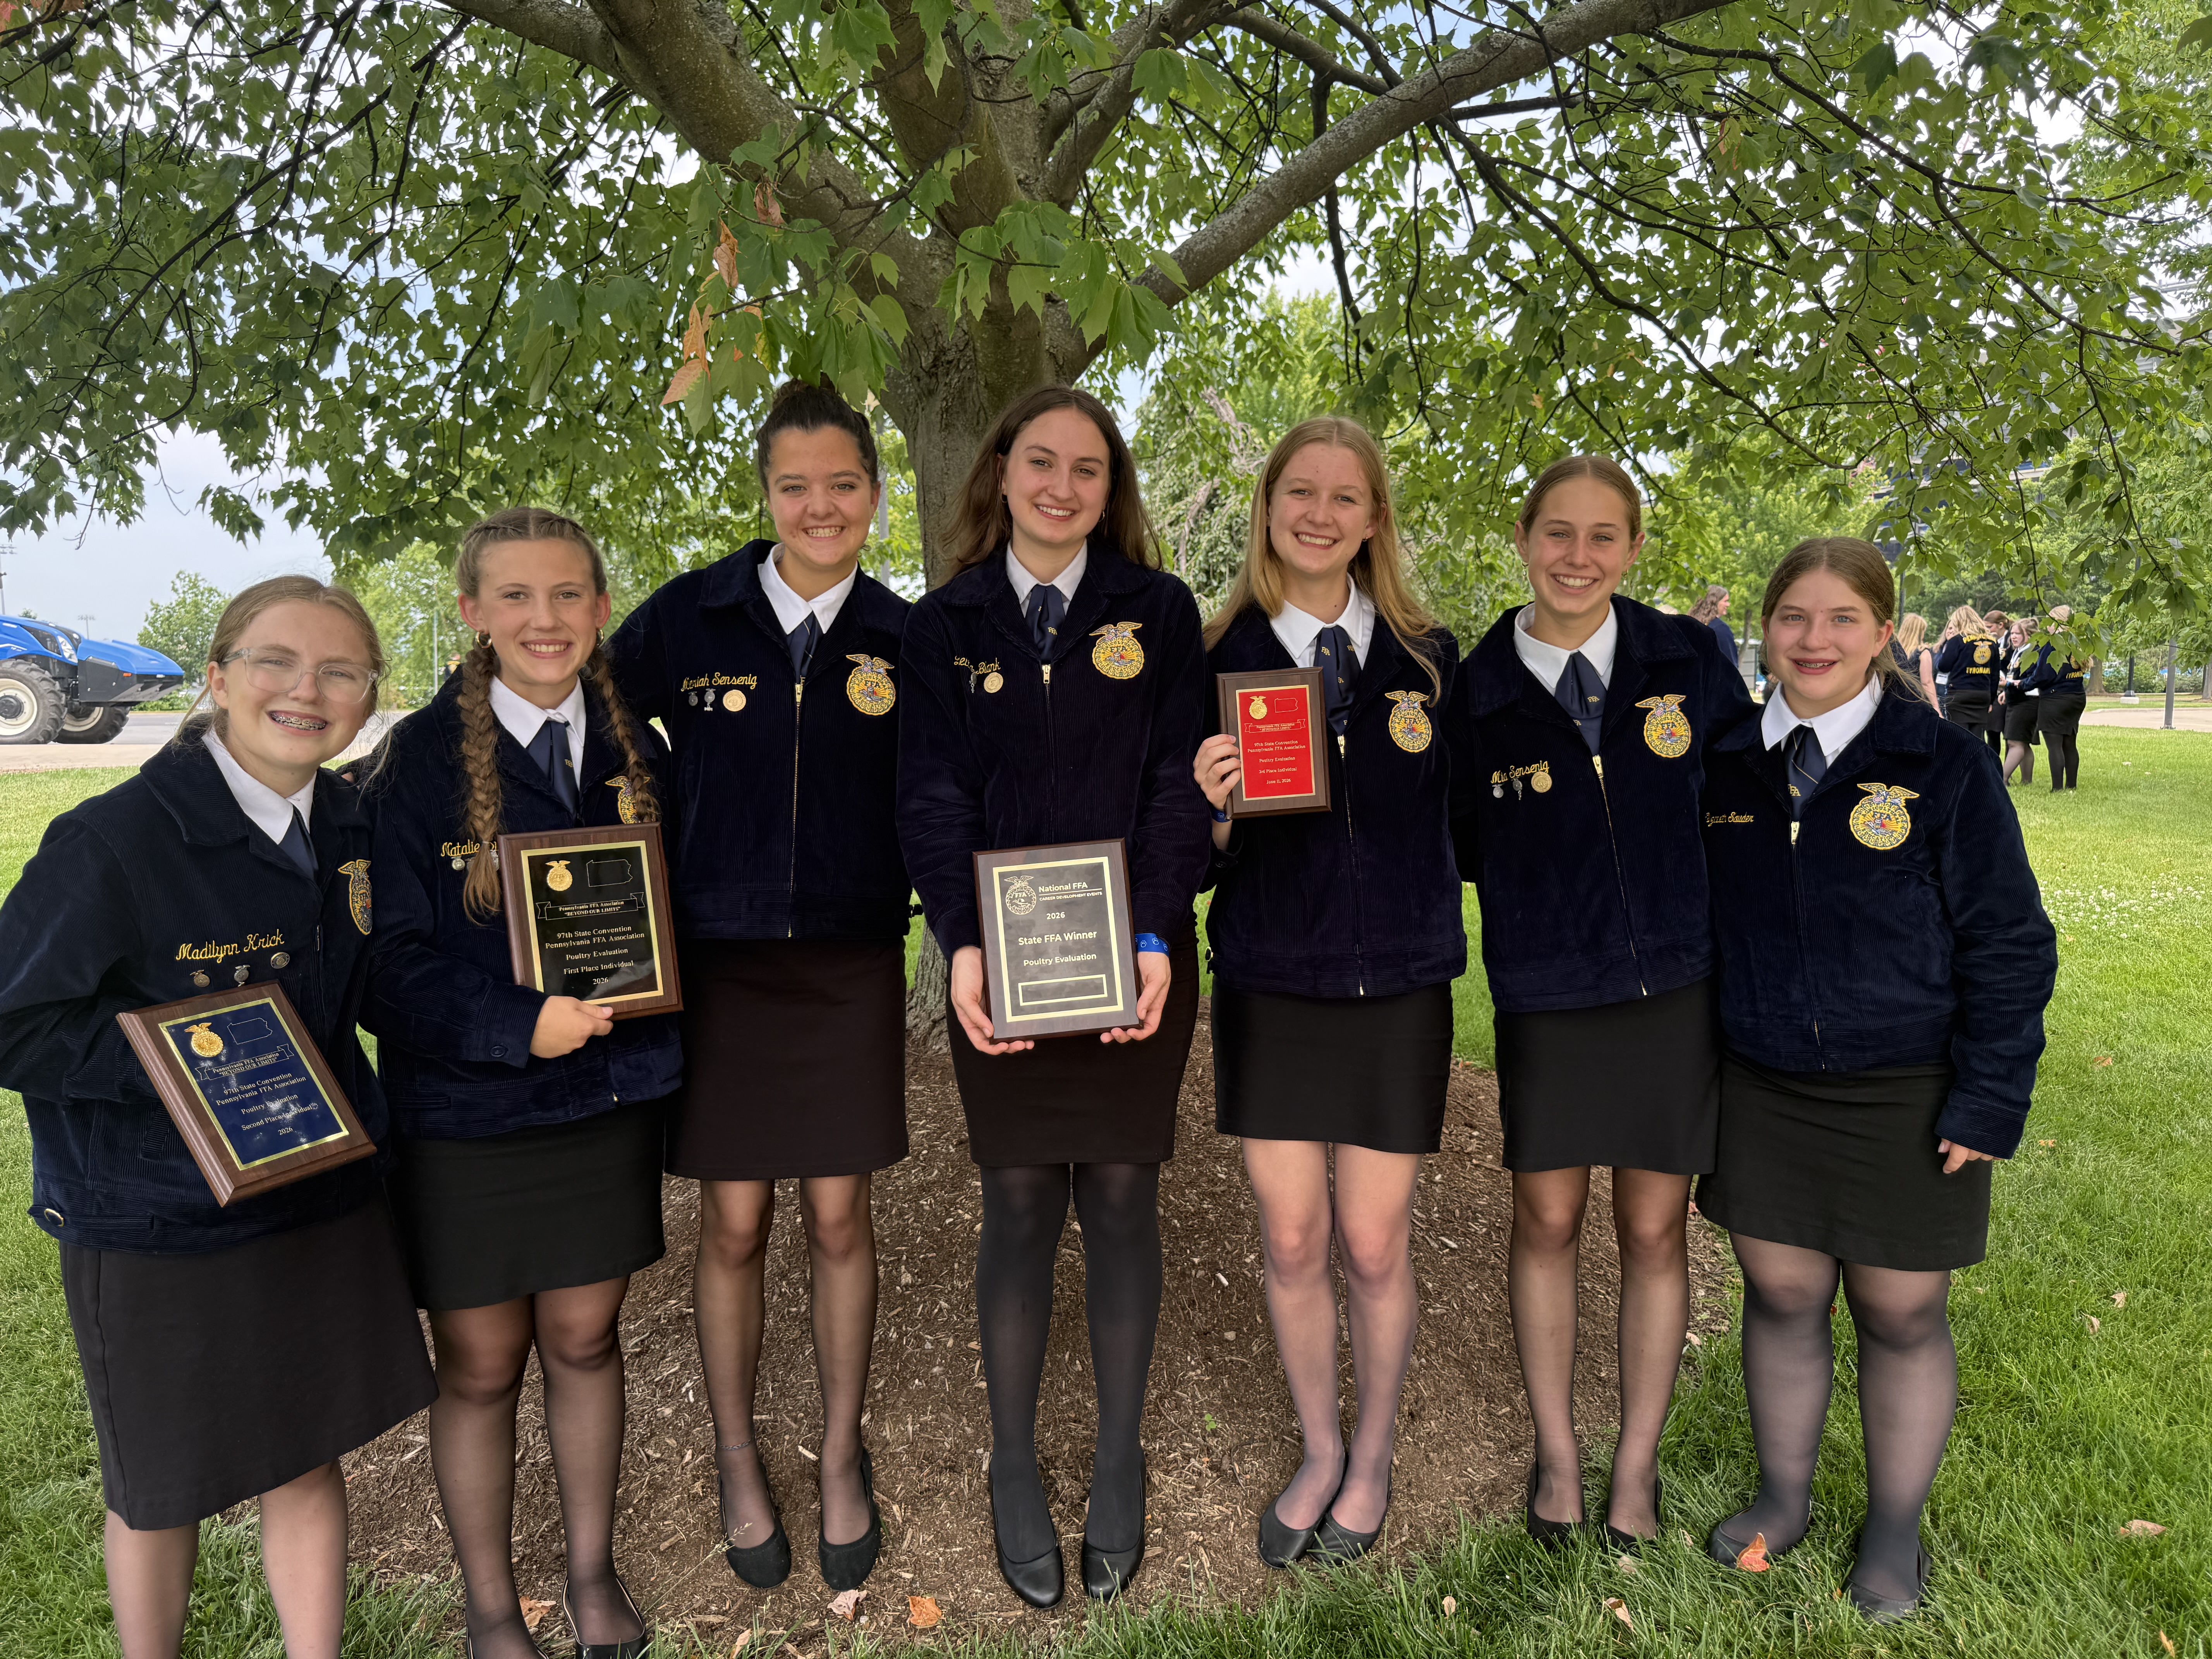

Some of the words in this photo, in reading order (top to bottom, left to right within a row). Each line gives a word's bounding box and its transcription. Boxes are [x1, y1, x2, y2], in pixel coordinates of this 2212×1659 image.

[1048, 627, 1057, 635] FFA
[1321, 646, 1330, 656] FFA
[712, 672, 757, 689] Sensenig
[1491, 770, 1508, 783] Mia
[1509, 760, 1549, 778] Sensenig
[1728, 812, 1754, 823] Sauder
[1872, 811, 1892, 821] FFA
[441, 839, 480, 857] Natalie
[1039, 883, 1071, 893] National
[1046, 912, 1065, 920] 2026
[593, 926, 632, 935] Convention
[176, 940, 240, 963] Madilynn
[244, 929, 285, 952] Krick
[545, 938, 590, 949] Pennsylvania
[609, 932, 645, 942] Association
[1018, 936, 1042, 946] State
[1044, 934, 1062, 943] FFA
[1063, 931, 1097, 941] Winner
[566, 953, 591, 961] Poultry
[594, 948, 628, 957] Evaluation
[1024, 958, 1053, 966] Poultry
[1055, 953, 1097, 963] Evaluation
[564, 967, 579, 975] First
[581, 965, 599, 973] Place
[601, 960, 634, 970] Individual
[592, 977, 609, 985] 2026
[213, 1062, 244, 1074] Pennsylvania
[255, 1052, 280, 1063] Association
[216, 1090, 258, 1106] Pennsylvania
[274, 1076, 306, 1090] Association
[224, 1087, 239, 1096] 97th
[257, 1073, 292, 1086] Convention
[241, 1103, 265, 1115] Poultry
[266, 1094, 299, 1108] Evaluation
[241, 1119, 264, 1131] Second
[264, 1114, 282, 1124] Place
[282, 1104, 313, 1118] Individual
[278, 1127, 294, 1135] 2026
